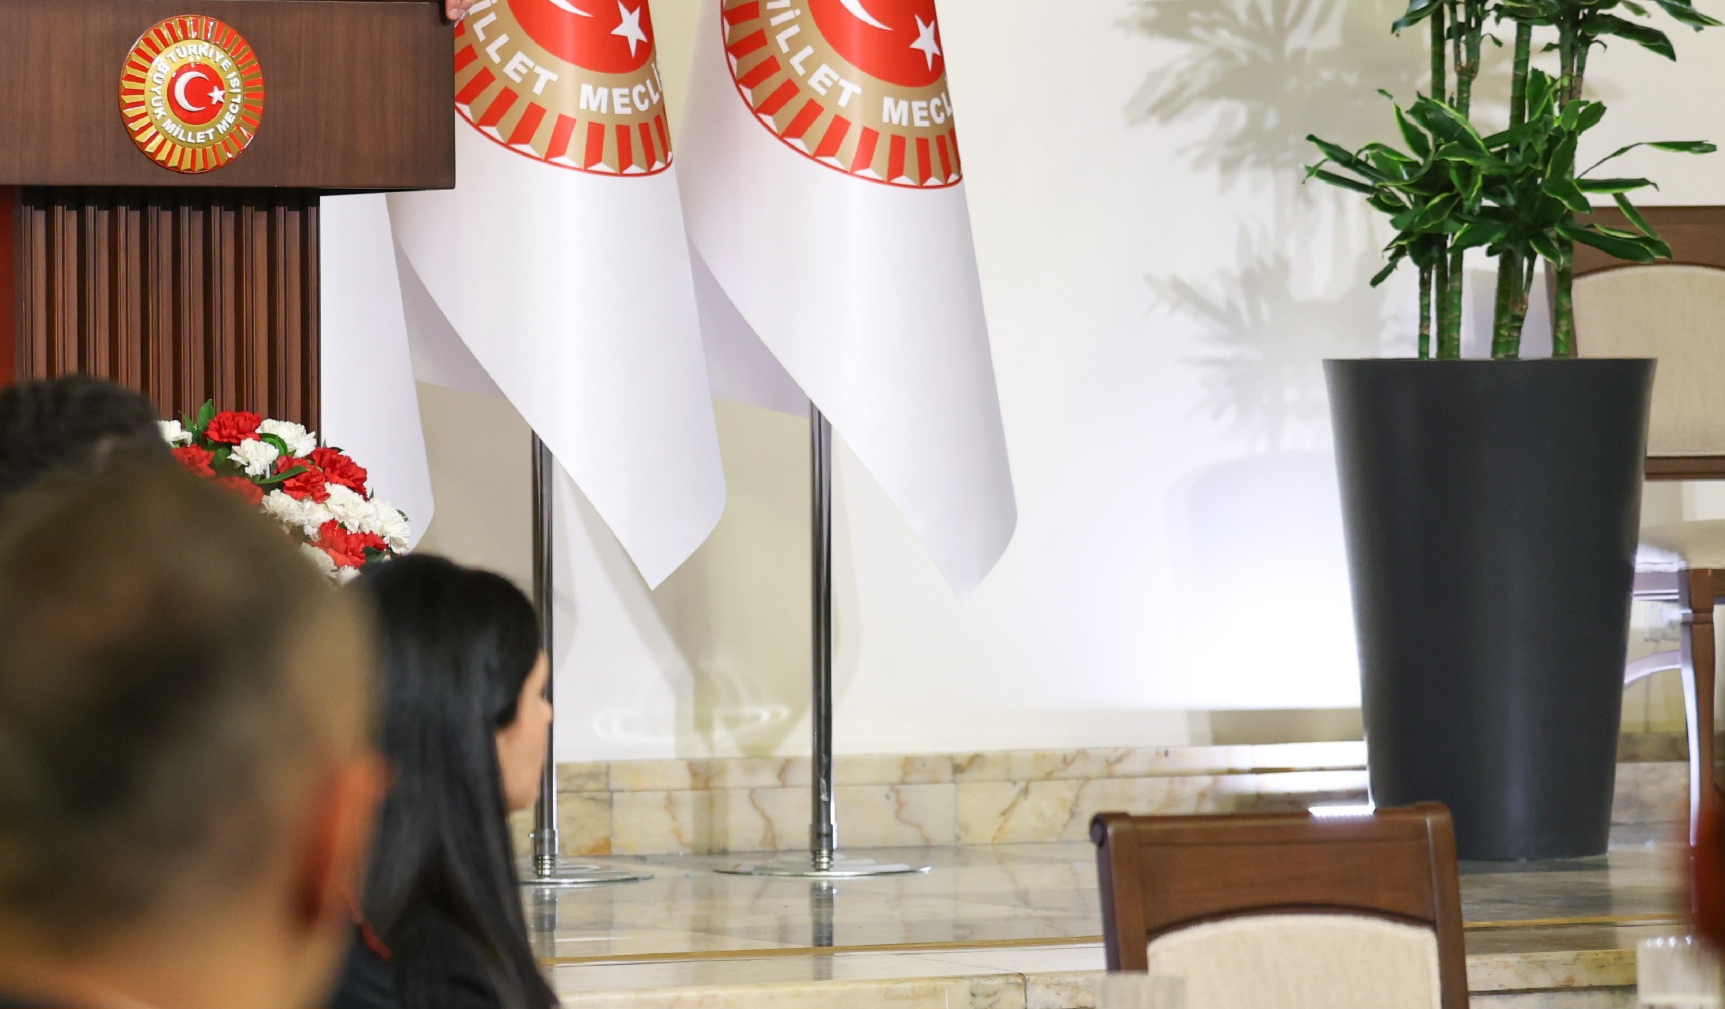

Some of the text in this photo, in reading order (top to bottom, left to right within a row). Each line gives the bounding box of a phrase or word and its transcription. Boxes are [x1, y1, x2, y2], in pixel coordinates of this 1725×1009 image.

[165, 43, 232, 72] TÜRKİYE
[150, 61, 242, 144] BÜYÜK MİLLET MECLİSİ
